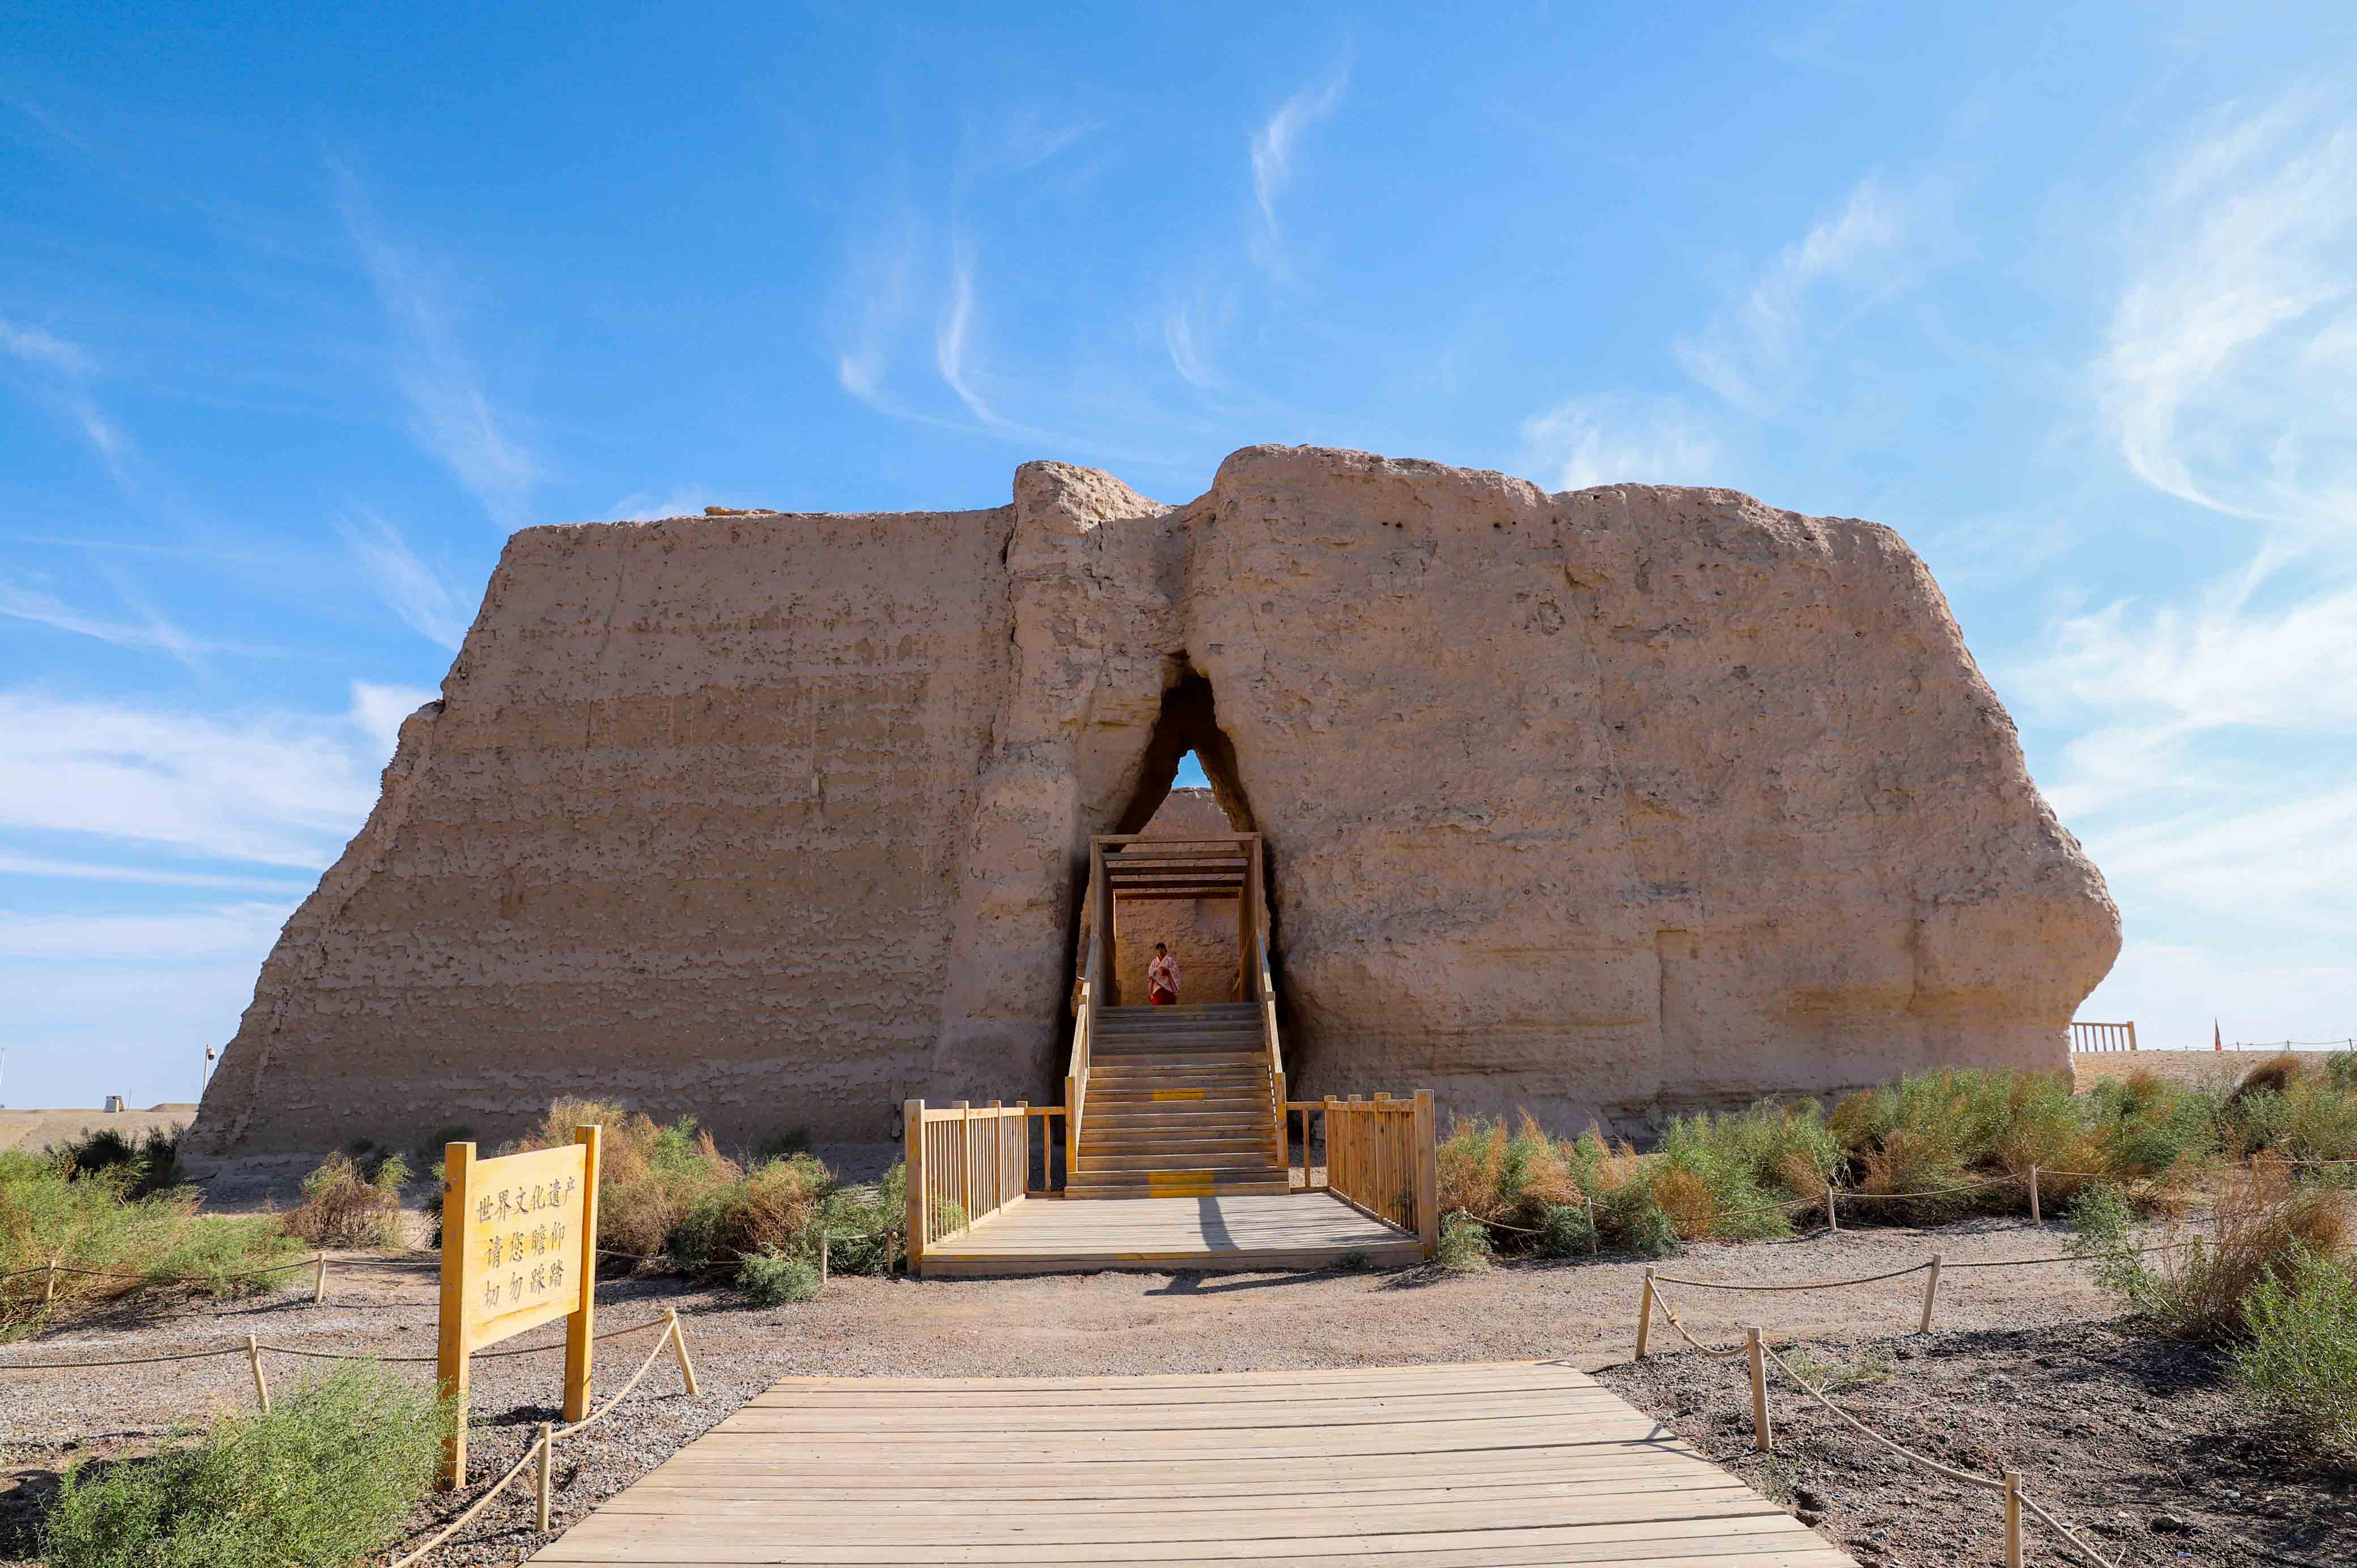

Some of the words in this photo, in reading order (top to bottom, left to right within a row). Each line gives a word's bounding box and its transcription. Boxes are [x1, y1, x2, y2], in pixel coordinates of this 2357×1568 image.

[476, 1177, 575, 1223] 世界文化遗产
[487, 1221, 565, 1269] 请您瞻仰
[484, 1259, 564, 1309] 切勿踩踏
